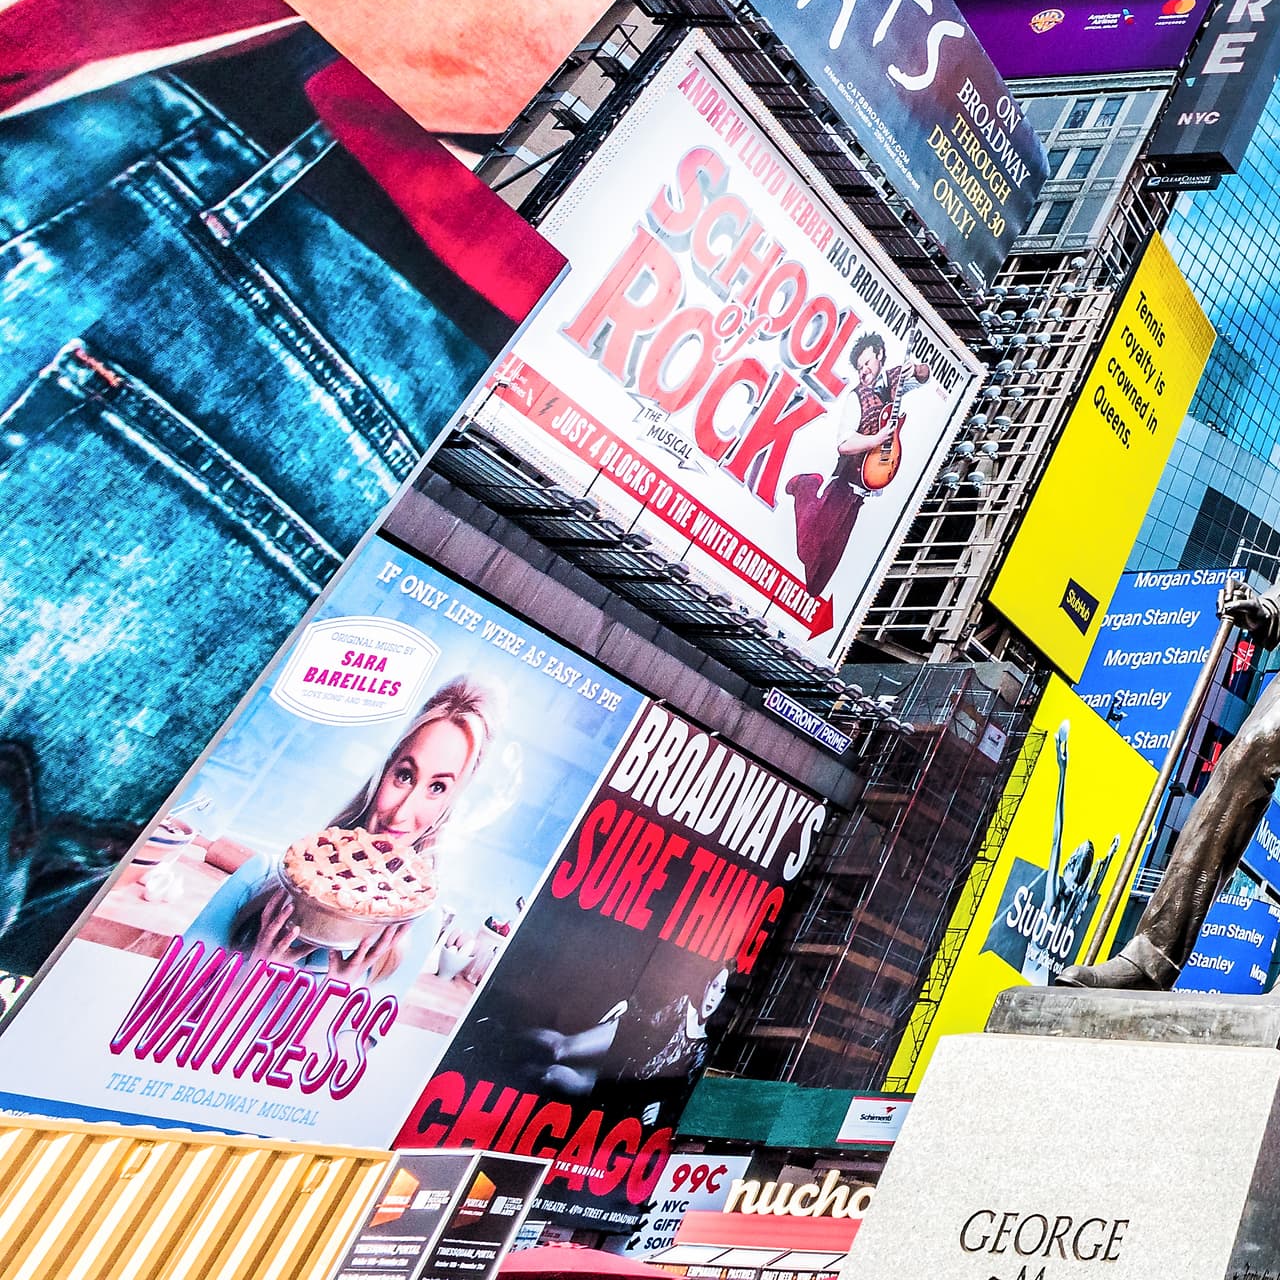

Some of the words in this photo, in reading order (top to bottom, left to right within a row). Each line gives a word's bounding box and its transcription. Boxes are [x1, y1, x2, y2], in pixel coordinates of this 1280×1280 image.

[956, 77, 1031, 189] BROADWAY
[996, 95, 1023, 134] ON
[1177, 110, 1220, 127] NYC
[927, 124, 990, 220] DECEMBER
[988, 211, 1006, 238] 30
[951, 113, 1012, 206] THROUGH
[737, 132, 788, 196] LLOYD
[779, 179, 834, 255] WEBBER
[826, 237, 857, 279] HAS
[850, 267, 915, 342] BROADWAY
[651, 142, 863, 399] SCHOOL
[1135, 291, 1166, 348] Tennis
[563, 224, 828, 511] ROCK
[1120, 325, 1156, 384] royalty
[1153, 371, 1166, 396] is
[1107, 357, 1150, 420] crowned
[1146, 409, 1158, 435] in
[649, 425, 694, 460] MUSICAL
[551, 407, 595, 443] JUST
[588, 436, 602, 460] 4
[600, 444, 651, 496] BLOCKS
[651, 480, 670, 510] TO
[668, 495, 697, 528] THE
[690, 511, 736, 561] WINTER
[734, 543, 782, 593] GARDEN
[774, 572, 822, 623] THEATRE
[1066, 588, 1090, 622] StubHub
[1133, 572, 1192, 591] Morgan
[1190, 569, 1246, 587] Stanley
[340, 650, 388, 673] SARA
[376, 561, 401, 585] IF
[399, 574, 449, 611] ONLY
[444, 600, 484, 633] LIFE
[481, 619, 526, 657] WERE
[521, 646, 547, 669] AS
[541, 656, 583, 692] EASY
[579, 679, 602, 701] AS
[595, 690, 623, 713] PIE
[770, 693, 822, 734] OUTFRONT
[820, 726, 848, 753] PRIME
[608, 705, 826, 881] BROADWAY'S
[552, 799, 690, 931] SURE
[658, 846, 785, 975] THING
[1005, 885, 1077, 959] StubHub
[1226, 927, 1265, 945] Stanley
[1188, 952, 1235, 974] Stanley
[110, 935, 399, 1101] WAITRESS
[104, 1072, 137, 1095] THE
[143, 1081, 170, 1100] HIT
[171, 1084, 260, 1114] BROADWAY
[259, 1101, 321, 1126] MUSICAL
[390, 1070, 673, 1205] CHICAGO
[555, 1160, 570, 1172] THE
[571, 1163, 605, 1179] MUSICAL
[661, 1200, 690, 1213] NYC
[670, 1164, 728, 1194] 99¢
[960, 1209, 1130, 1261] GEORGE
